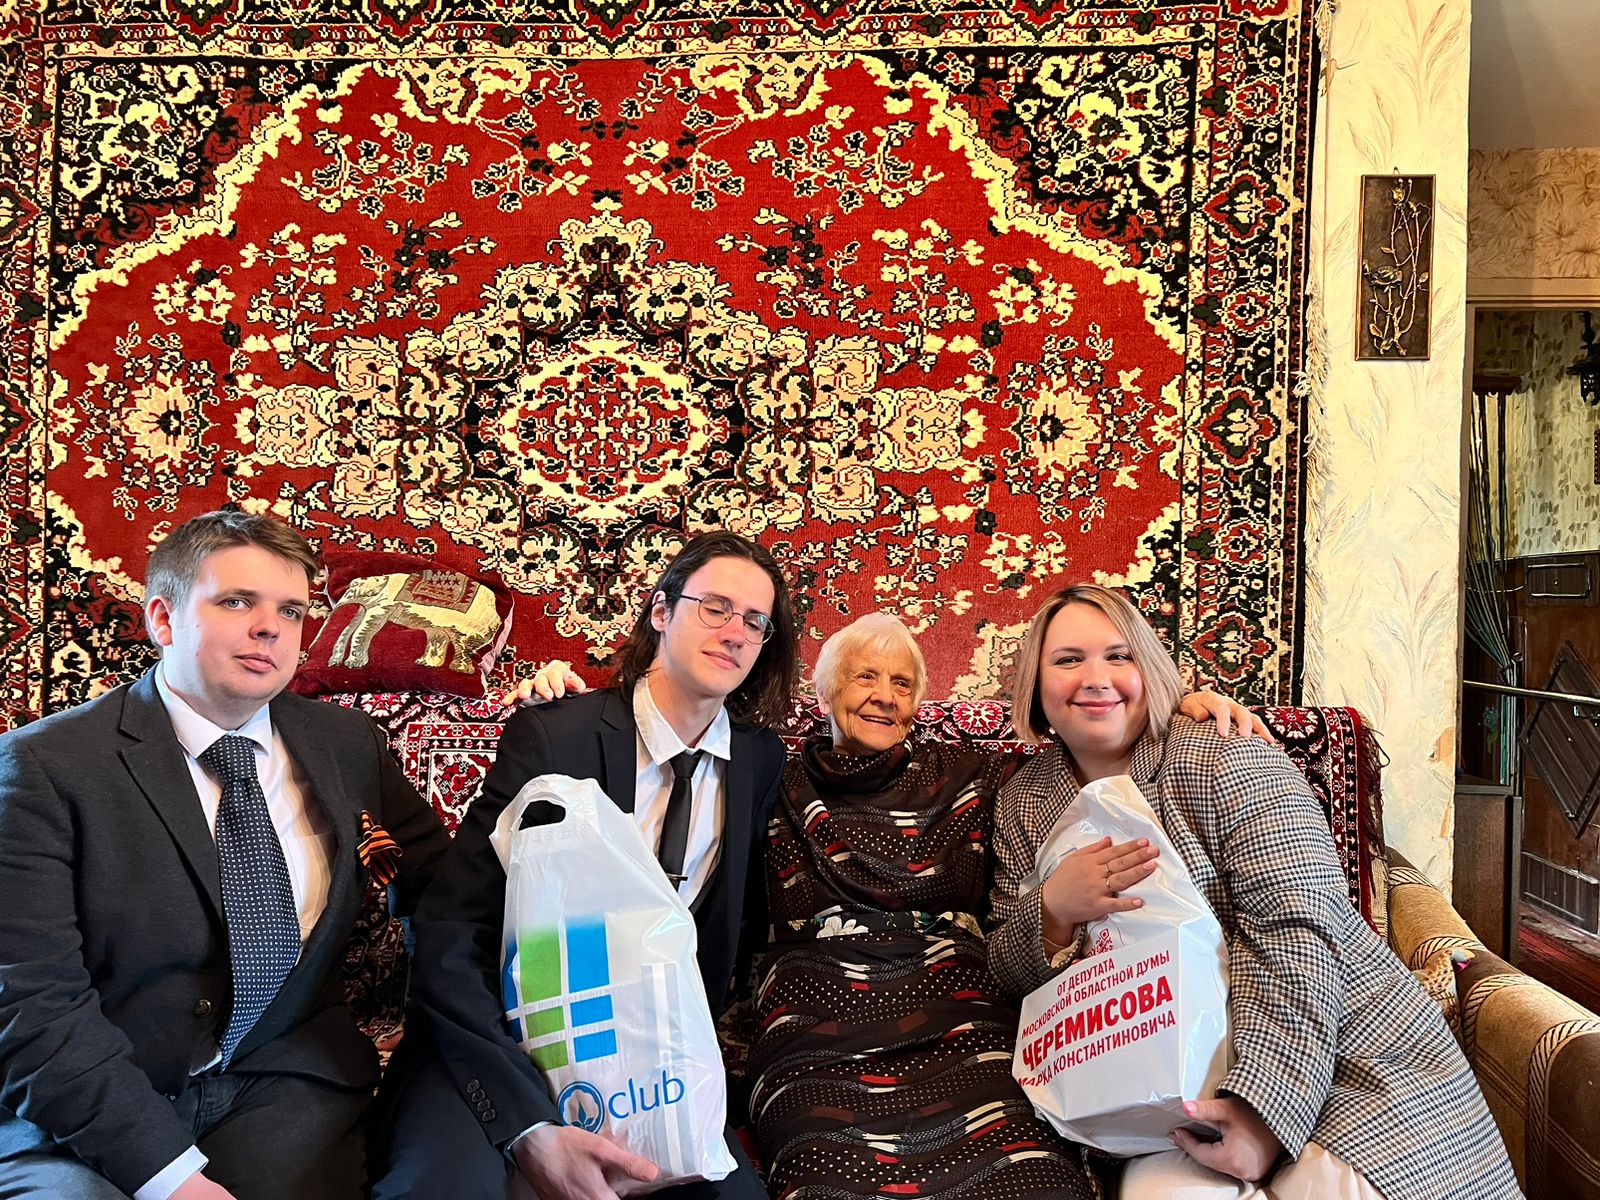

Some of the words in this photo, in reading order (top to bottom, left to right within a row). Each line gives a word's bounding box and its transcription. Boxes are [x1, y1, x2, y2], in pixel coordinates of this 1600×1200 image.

[1022, 993, 1071, 1039] МОСКОВСКОЙ
[1074, 965, 1134, 1003] ОБЛАСТНОЙ
[1136, 950, 1170, 979] ДУМЫ
[1057, 981, 1067, 996] ОТ
[1068, 958, 1115, 992] ДЕПУТАТА
[1022, 976, 1173, 1072] ЧЕРЕМИСОВА
[1053, 1010, 1175, 1075] КОНСТАНТИНОВИЧА
[608, 1070, 685, 1119] club
